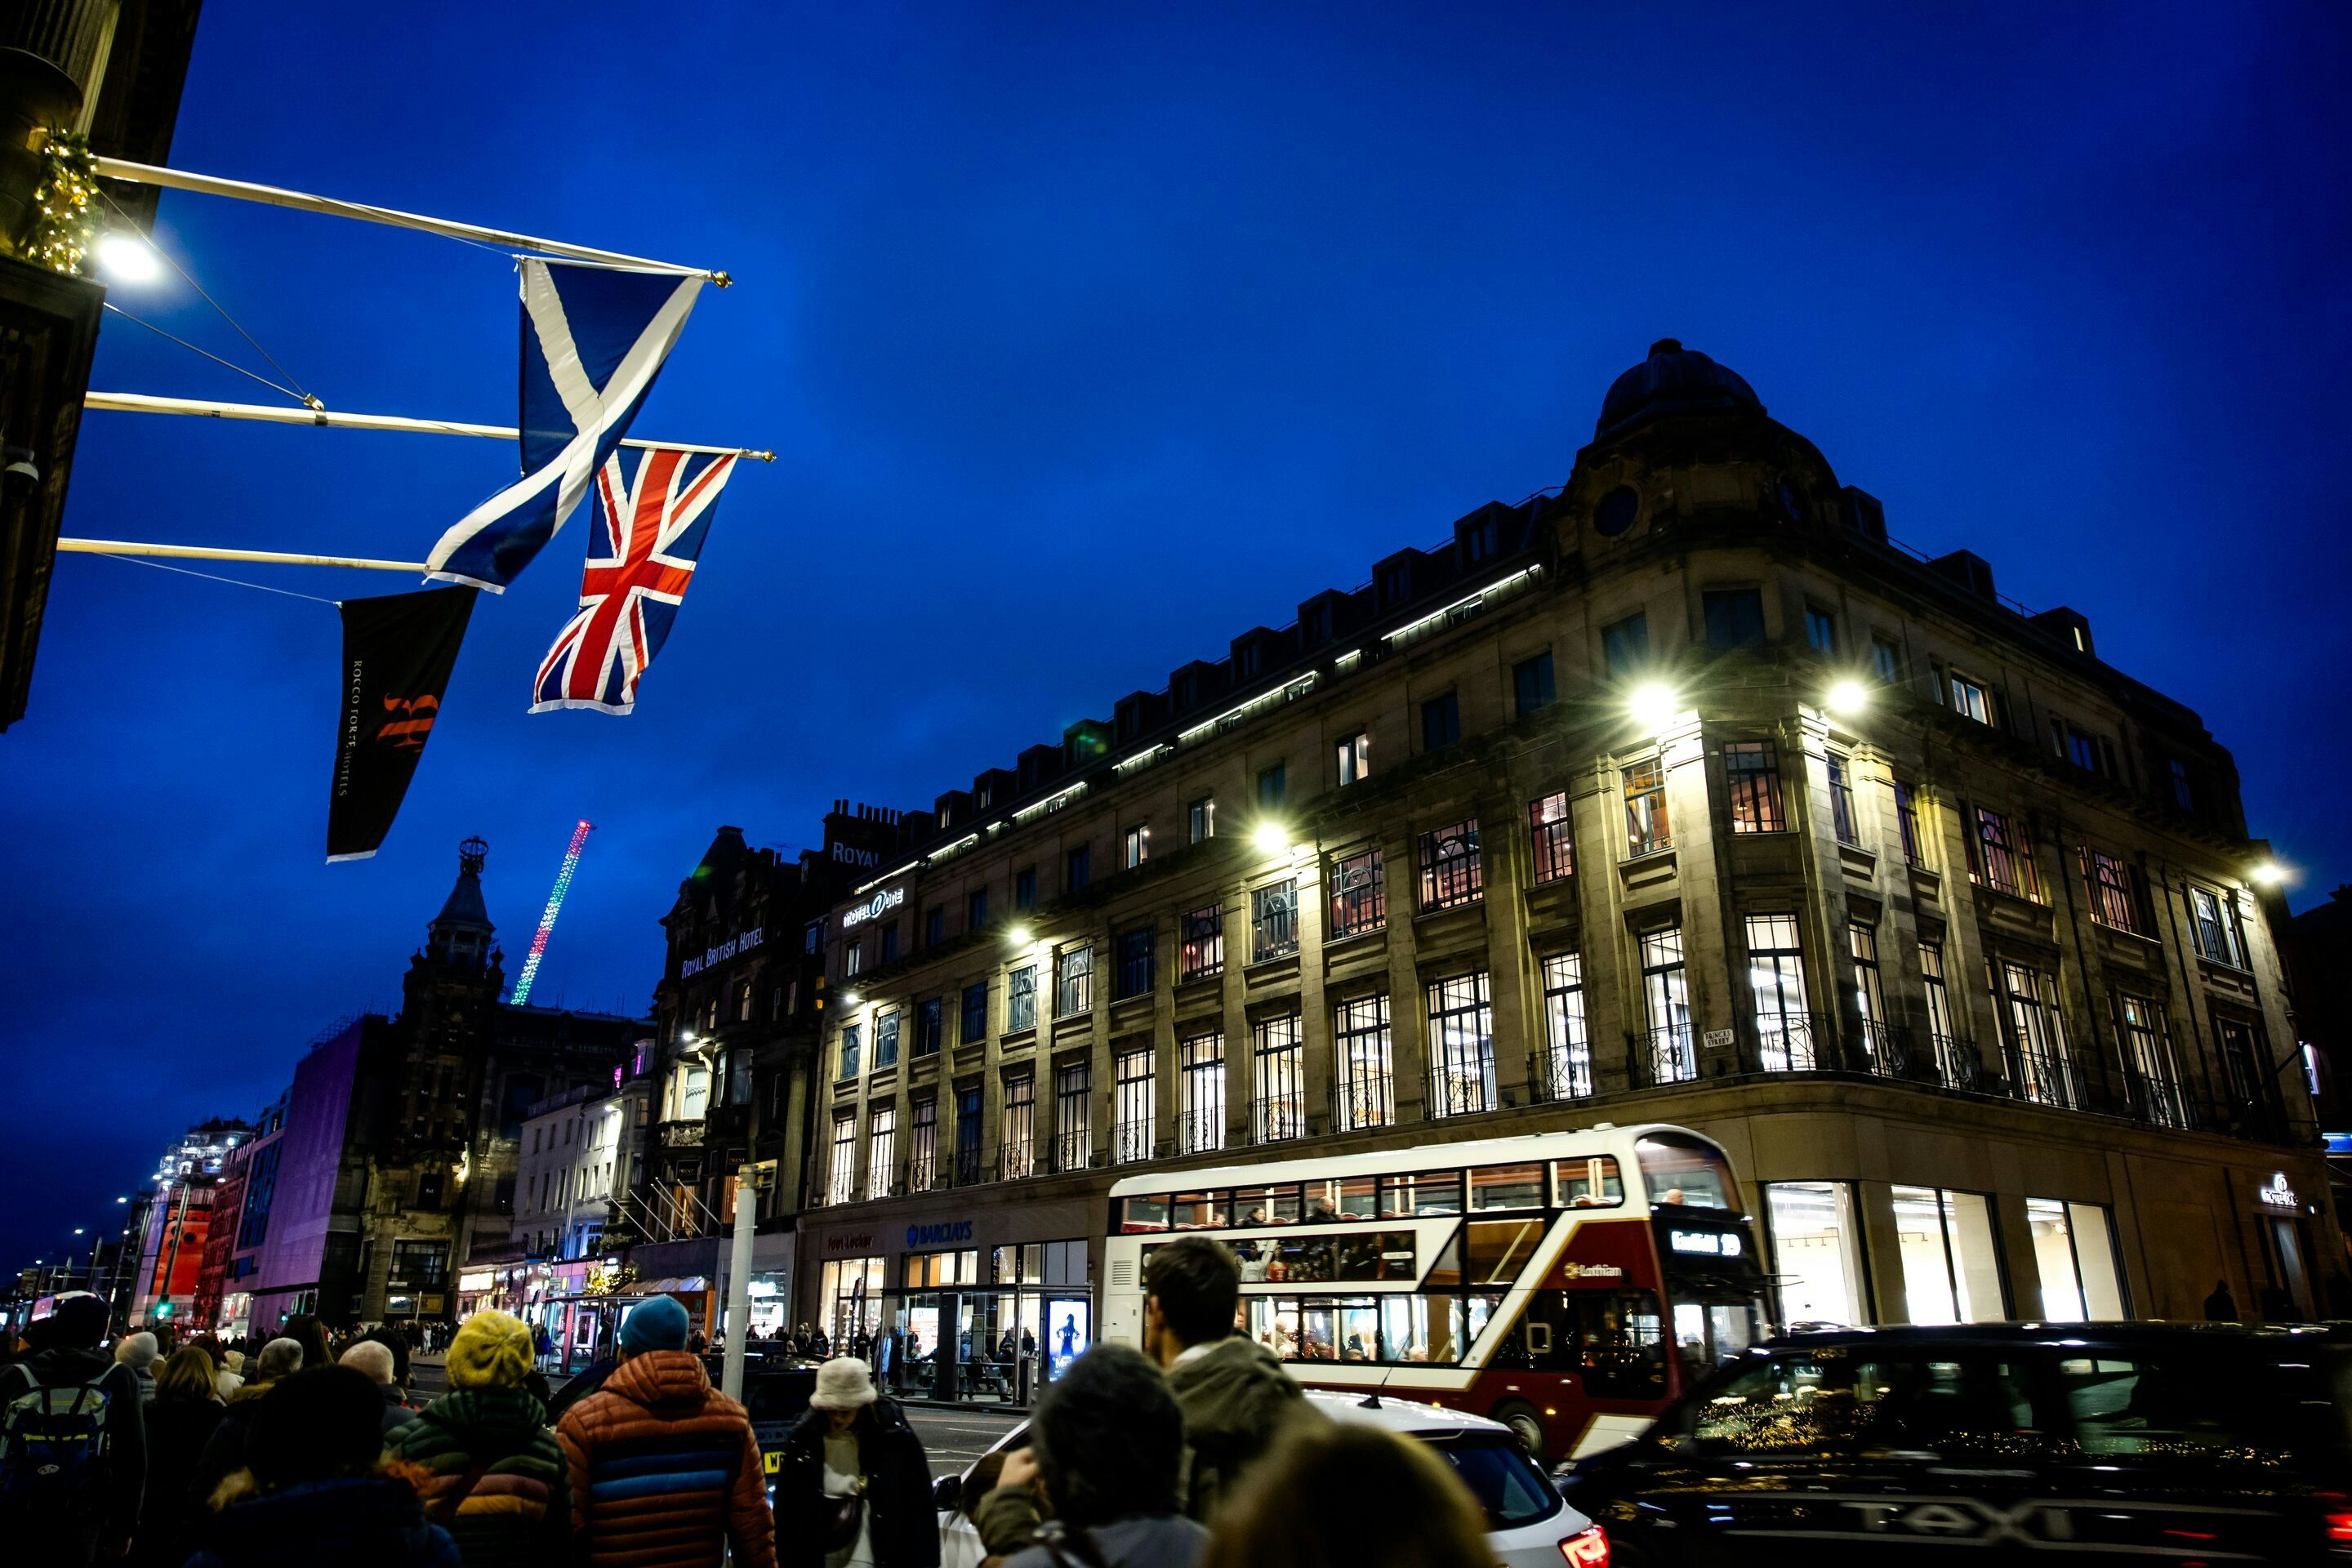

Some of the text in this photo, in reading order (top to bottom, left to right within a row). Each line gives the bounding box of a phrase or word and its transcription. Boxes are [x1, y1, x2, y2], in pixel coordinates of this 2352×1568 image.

[351, 660, 363, 705] ROCCO
[681, 927, 764, 979] ROYAL BRITISH HOTEL
[1705, 1030, 1731, 1040] PRINCES
[1708, 1037, 1730, 1045] STREET
[919, 1221, 973, 1244] BARCLAYS
[1838, 1500, 2075, 1544] TAXI
